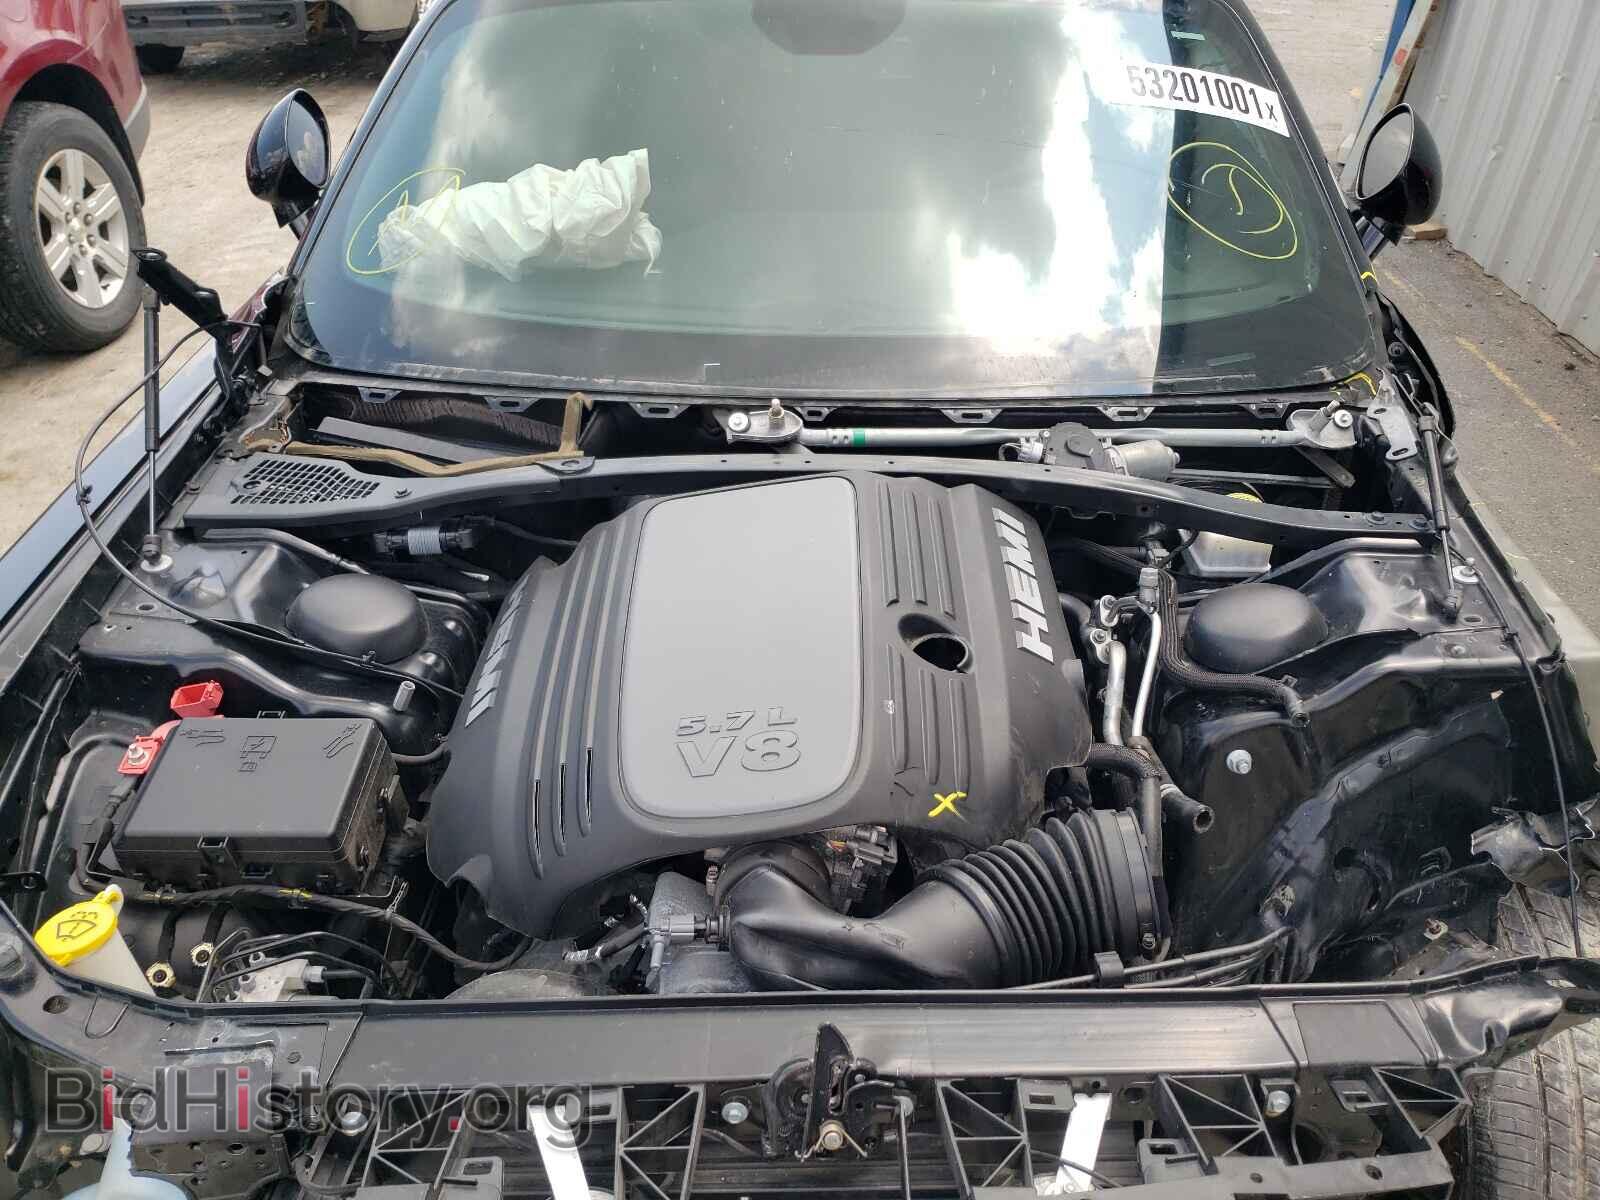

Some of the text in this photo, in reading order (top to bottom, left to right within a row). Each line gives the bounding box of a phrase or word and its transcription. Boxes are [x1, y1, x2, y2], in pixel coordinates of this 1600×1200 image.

[992, 507, 1054, 664] HEMI
[676, 706, 797, 737] 5.7 L
[675, 729, 801, 778] V8
